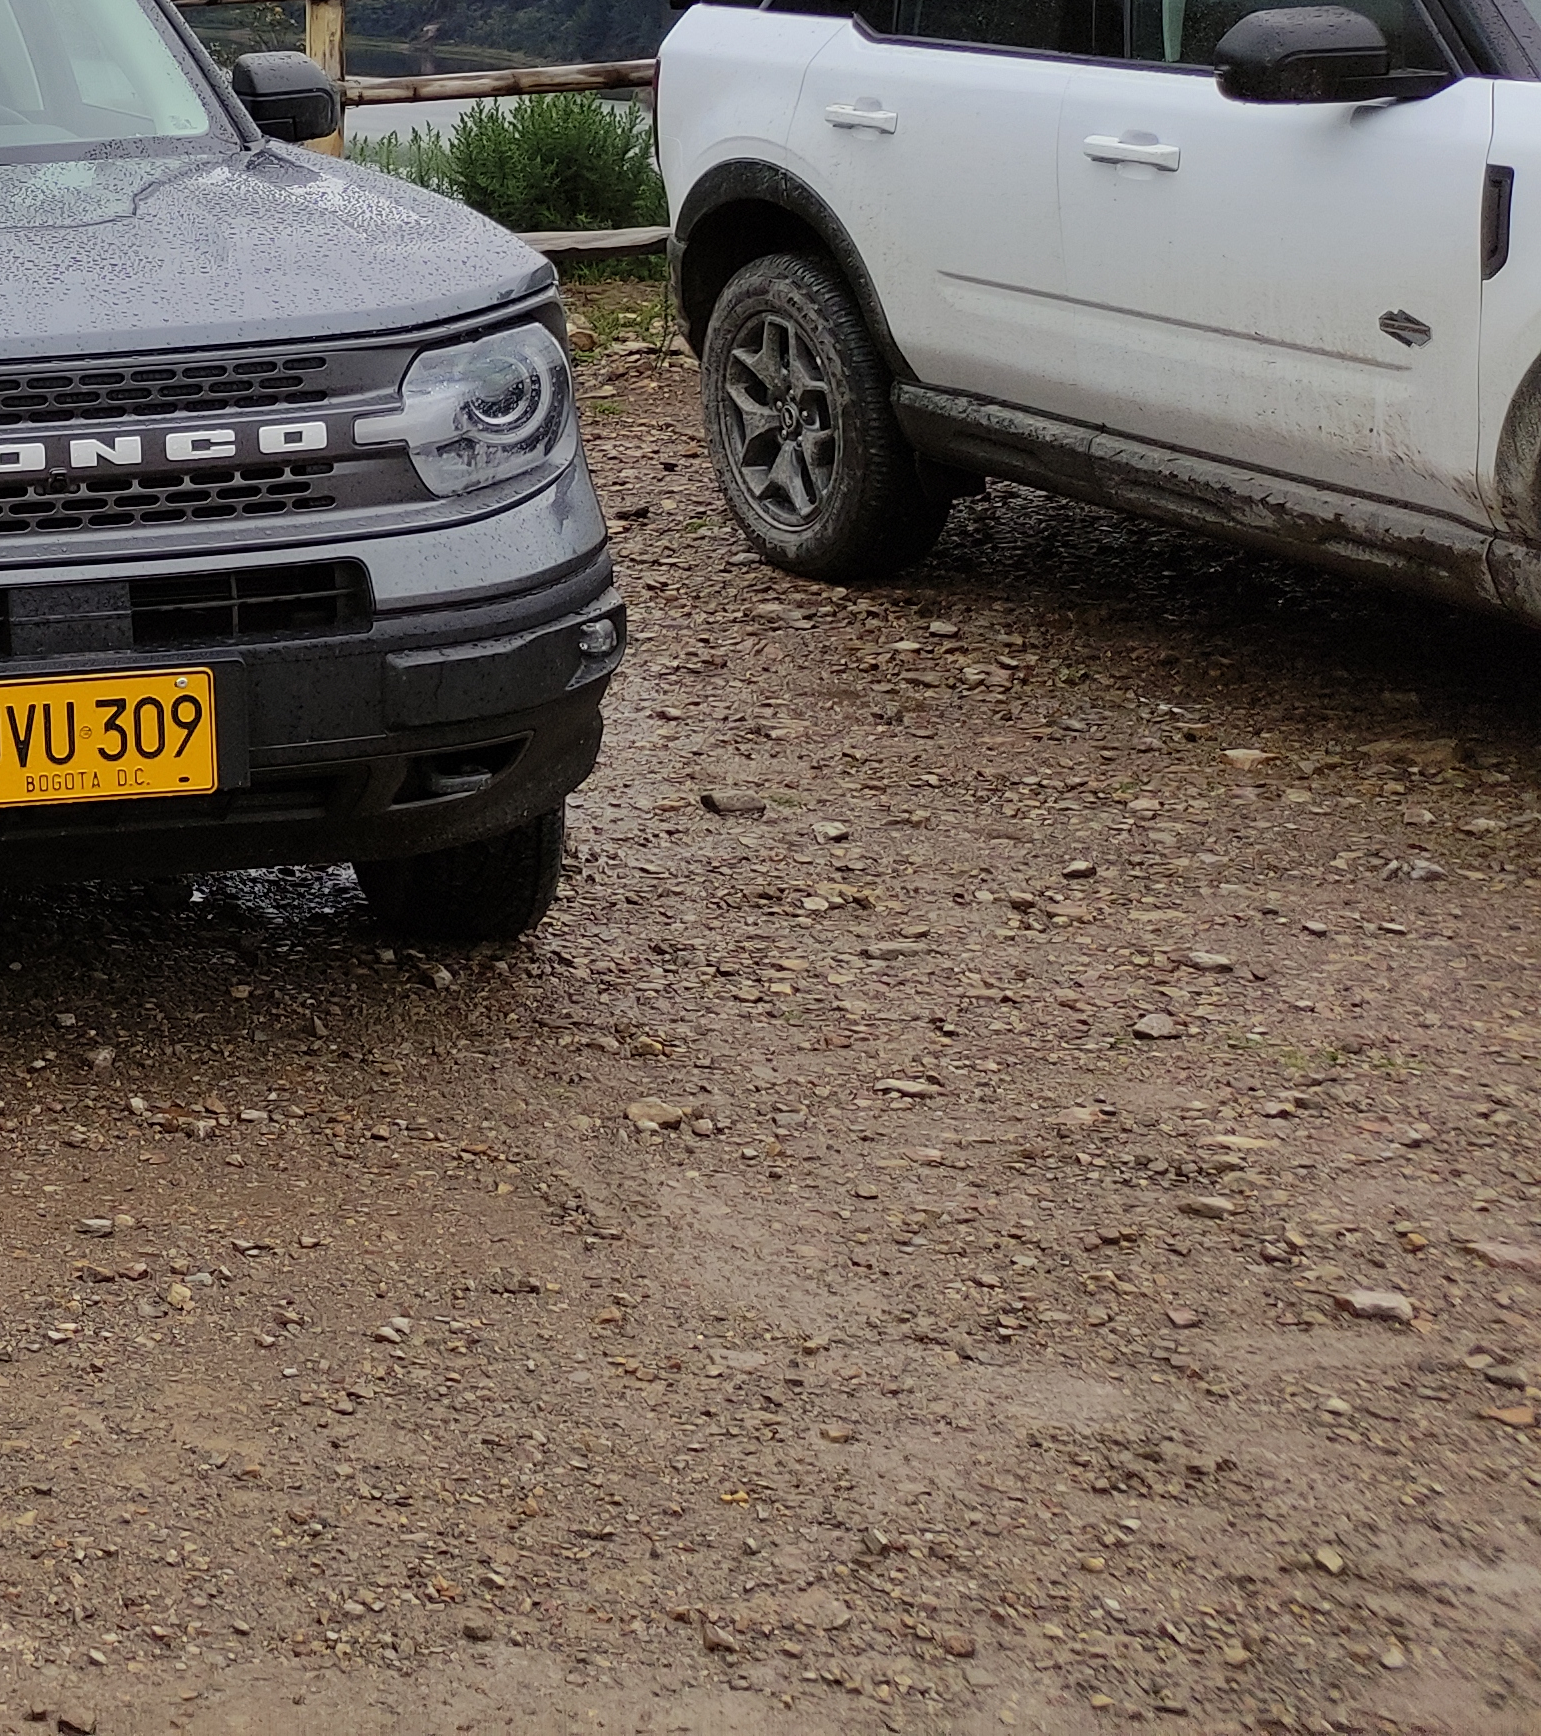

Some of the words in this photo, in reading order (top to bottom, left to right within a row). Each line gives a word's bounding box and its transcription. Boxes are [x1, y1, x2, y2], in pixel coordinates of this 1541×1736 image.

[94, 693, 203, 763] 309
[25, 771, 101, 794] BOGOTA
[116, 767, 152, 788] D.C.
